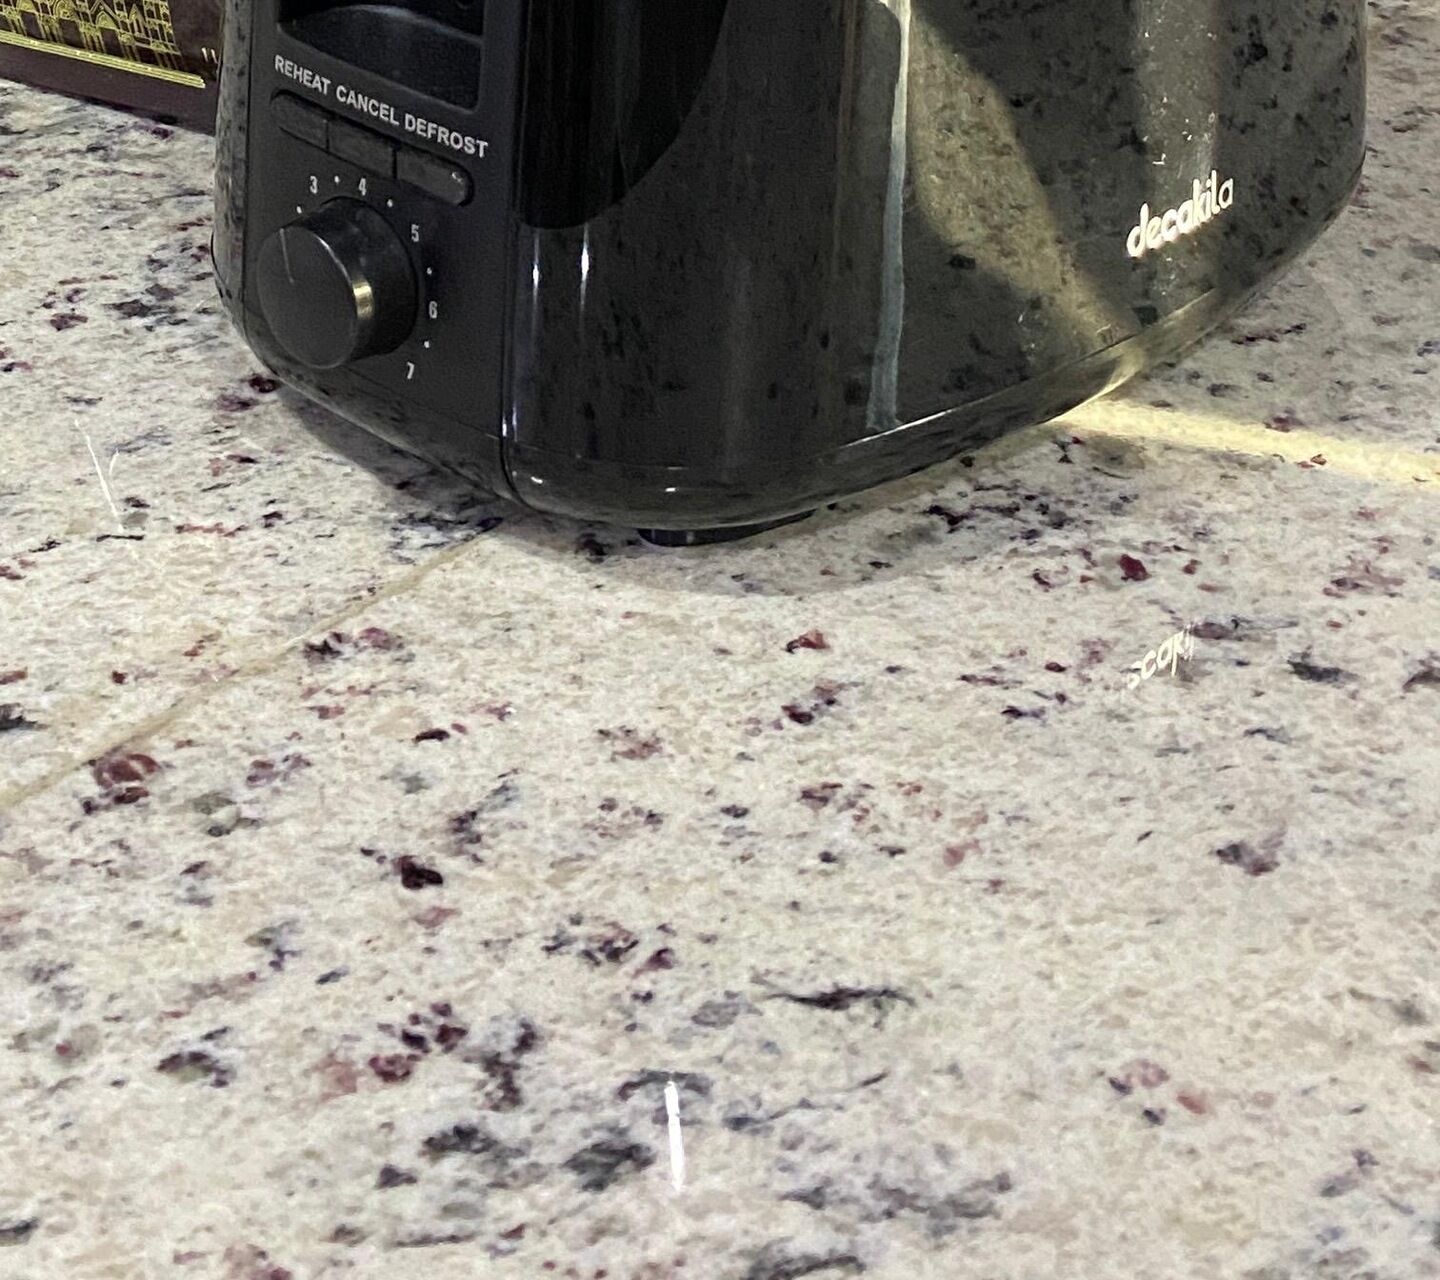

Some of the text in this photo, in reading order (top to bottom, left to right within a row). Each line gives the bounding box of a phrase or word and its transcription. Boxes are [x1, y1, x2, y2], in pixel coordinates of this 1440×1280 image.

[274, 54, 489, 158] REHEAT CANCEL DEFROST
[309, 176, 367, 196] 3 4
[1126, 169, 1234, 258] decakila
[410, 224, 420, 242] 5
[428, 300, 438, 320] 6
[405, 361, 416, 380] 7
